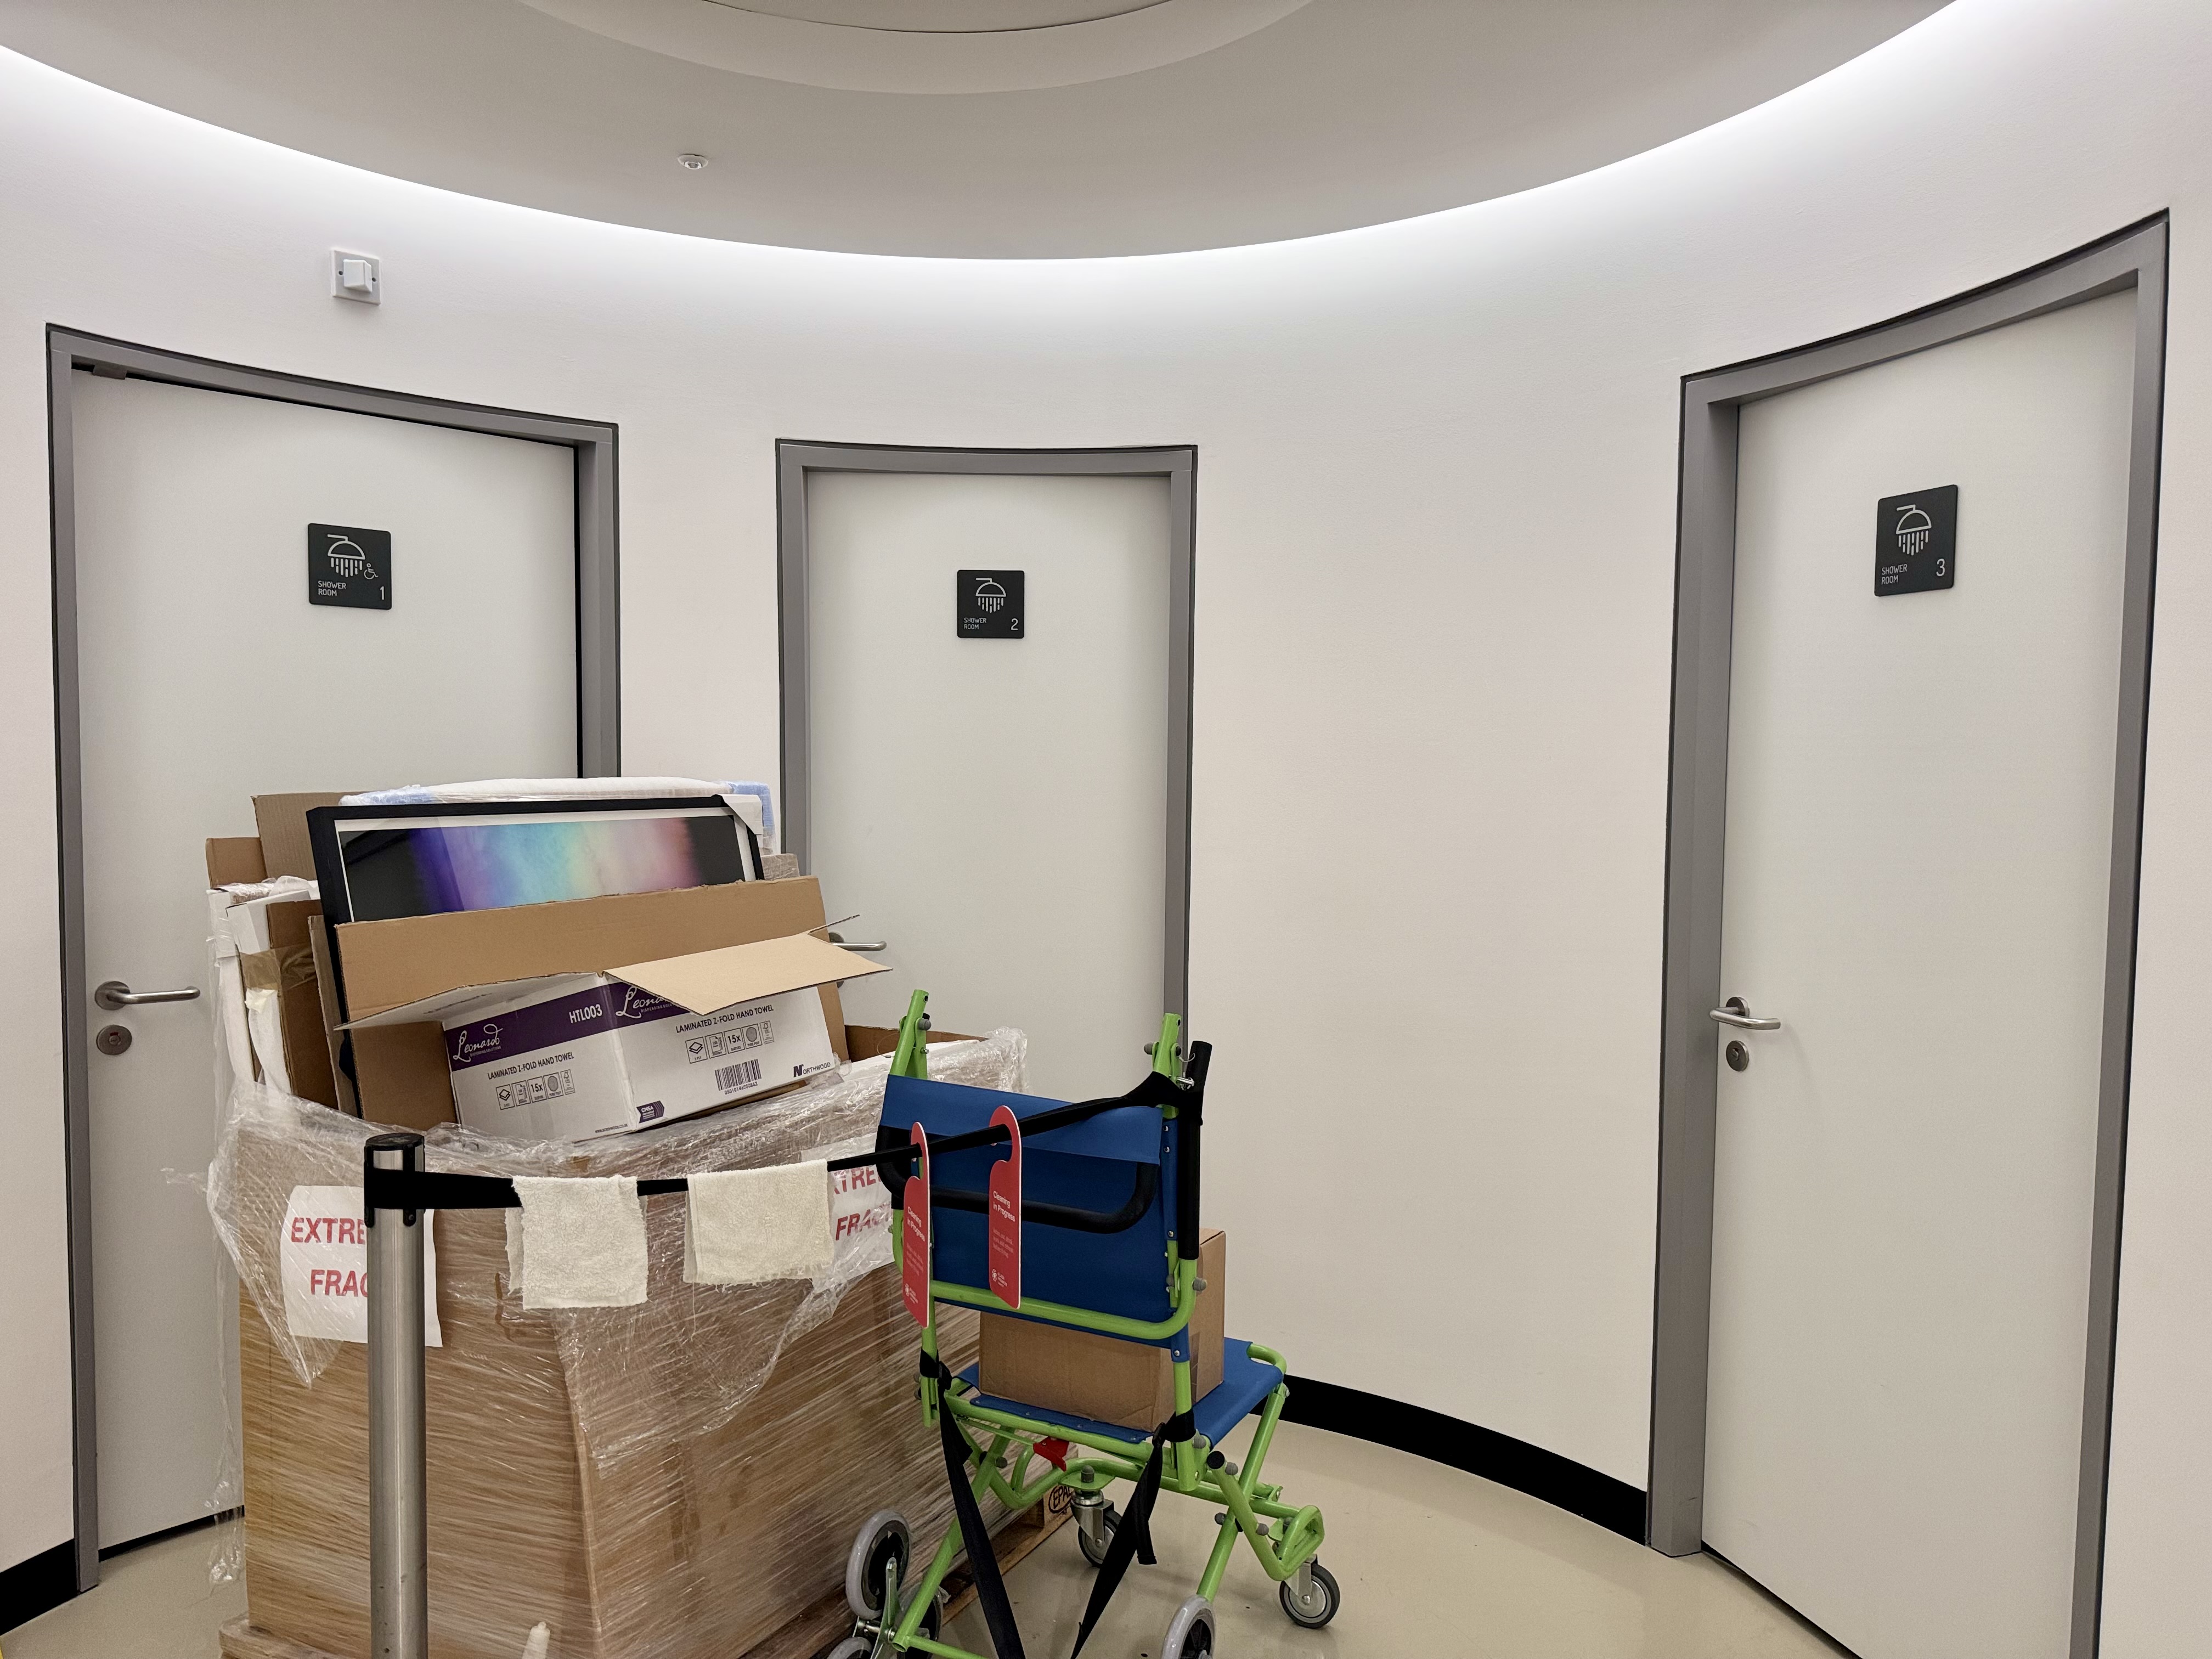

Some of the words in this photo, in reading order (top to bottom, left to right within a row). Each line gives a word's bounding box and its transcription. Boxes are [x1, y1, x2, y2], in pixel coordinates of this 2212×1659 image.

[1881, 563, 1908, 575] SHOWER
[1936, 558, 1945, 577] 3
[318, 580, 347, 590] SHOWER
[1881, 575, 1898, 585] ROOM
[380, 586, 385, 600] 1
[1011, 618, 1018, 630] 2
[616, 986, 670, 1019] Leona
[569, 1004, 603, 1024] HTL003
[676, 1019, 712, 1034] LAMINATED
[713, 1014, 735, 1025] Z-FOLD
[736, 1009, 753, 1019] HAND
[754, 1005, 774, 1015] TOWEL
[453, 1024, 504, 1062] Leonardo
[727, 1034, 741, 1044] 15x
[488, 1066, 517, 1080] LAMINATED
[517, 1062, 537, 1073] Z-FOLD
[538, 1057, 554, 1067] HAND
[555, 1052, 574, 1063] TOWEL
[793, 1062, 831, 1077] NORTHWOOD
[531, 1083, 544, 1093] 15x
[993, 1190, 1011, 1209] Cleaning
[997, 1205, 1015, 1222] Progress
[291, 1217, 366, 1245] EXTRE
